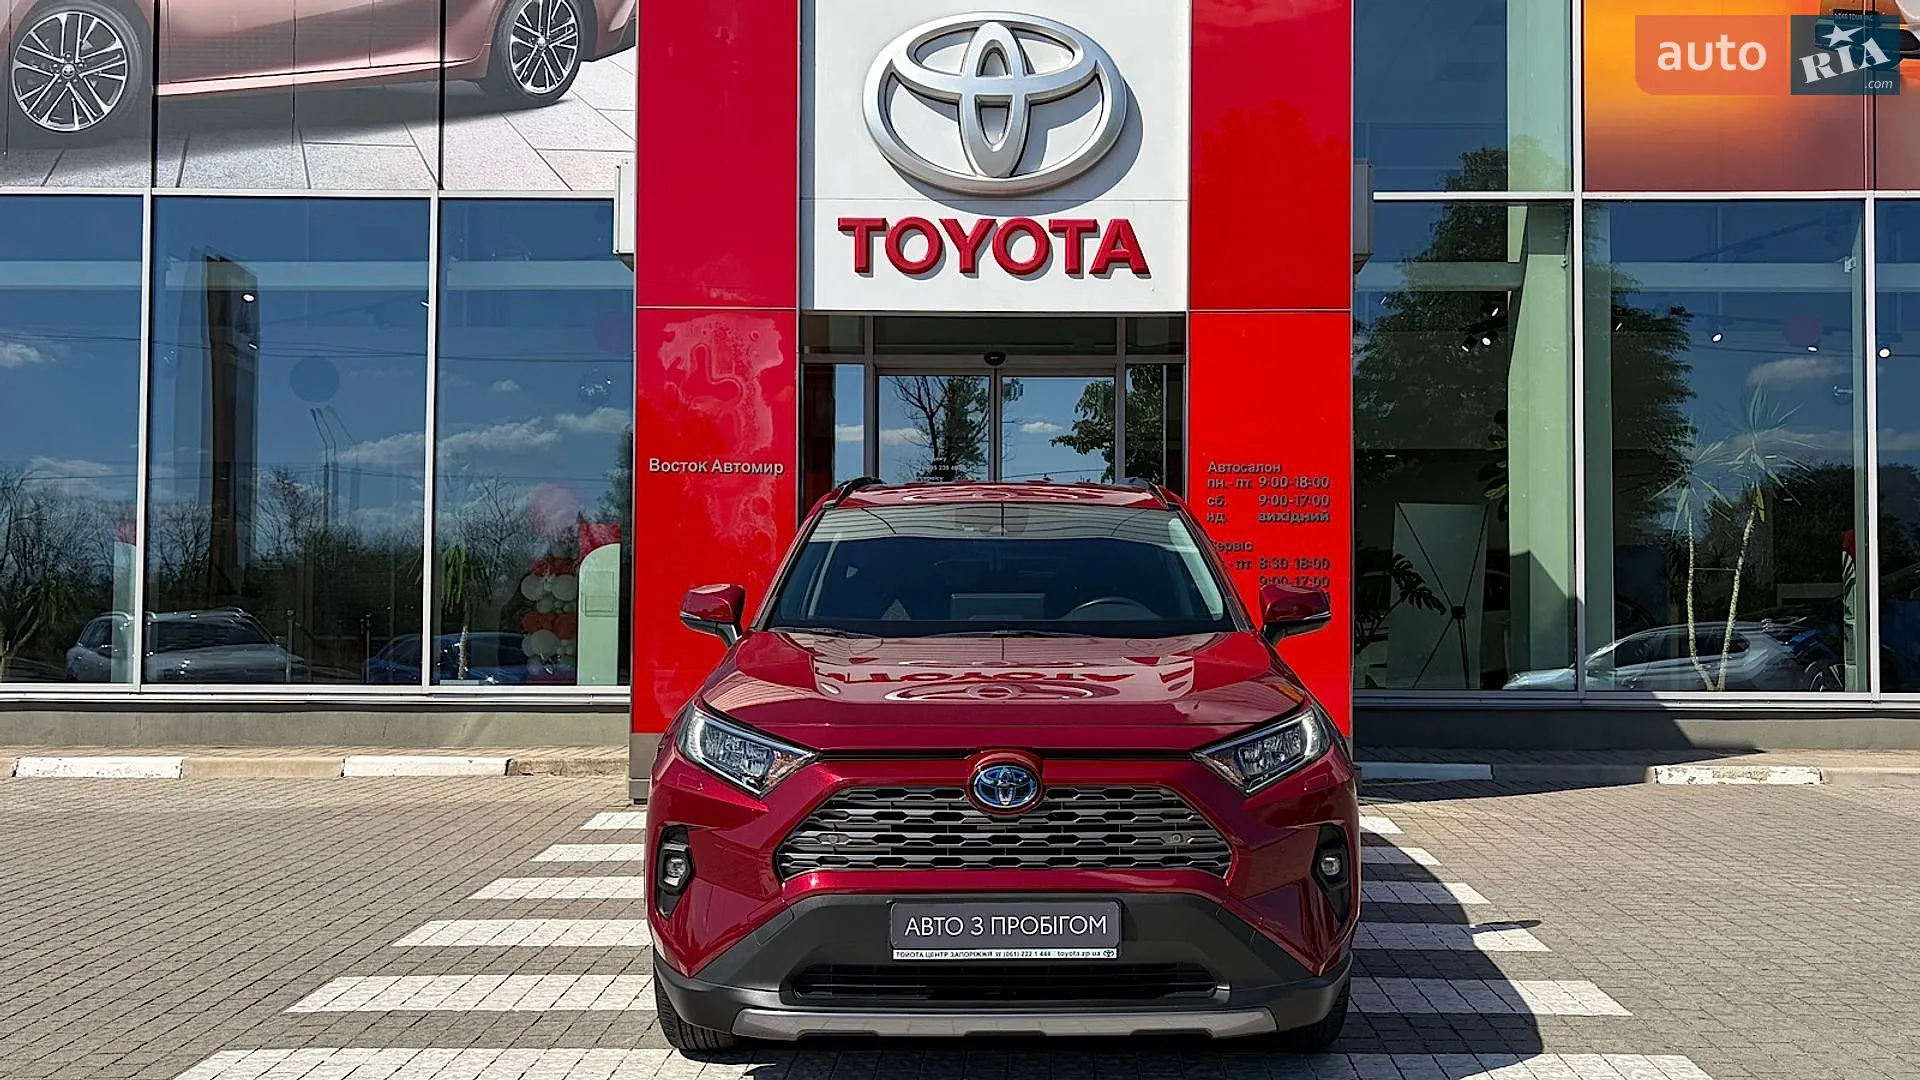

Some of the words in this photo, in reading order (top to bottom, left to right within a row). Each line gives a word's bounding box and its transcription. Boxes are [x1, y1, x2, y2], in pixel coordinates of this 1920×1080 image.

[837, 216, 1151, 276] TOYOTA
[649, 458, 708, 473] Восток
[711, 459, 784, 476] Автомир
[1207, 460, 1281, 474] Автосалон
[904, 917, 964, 936] АВТО
[991, 915, 1107, 935] ПРОБІГОМ
